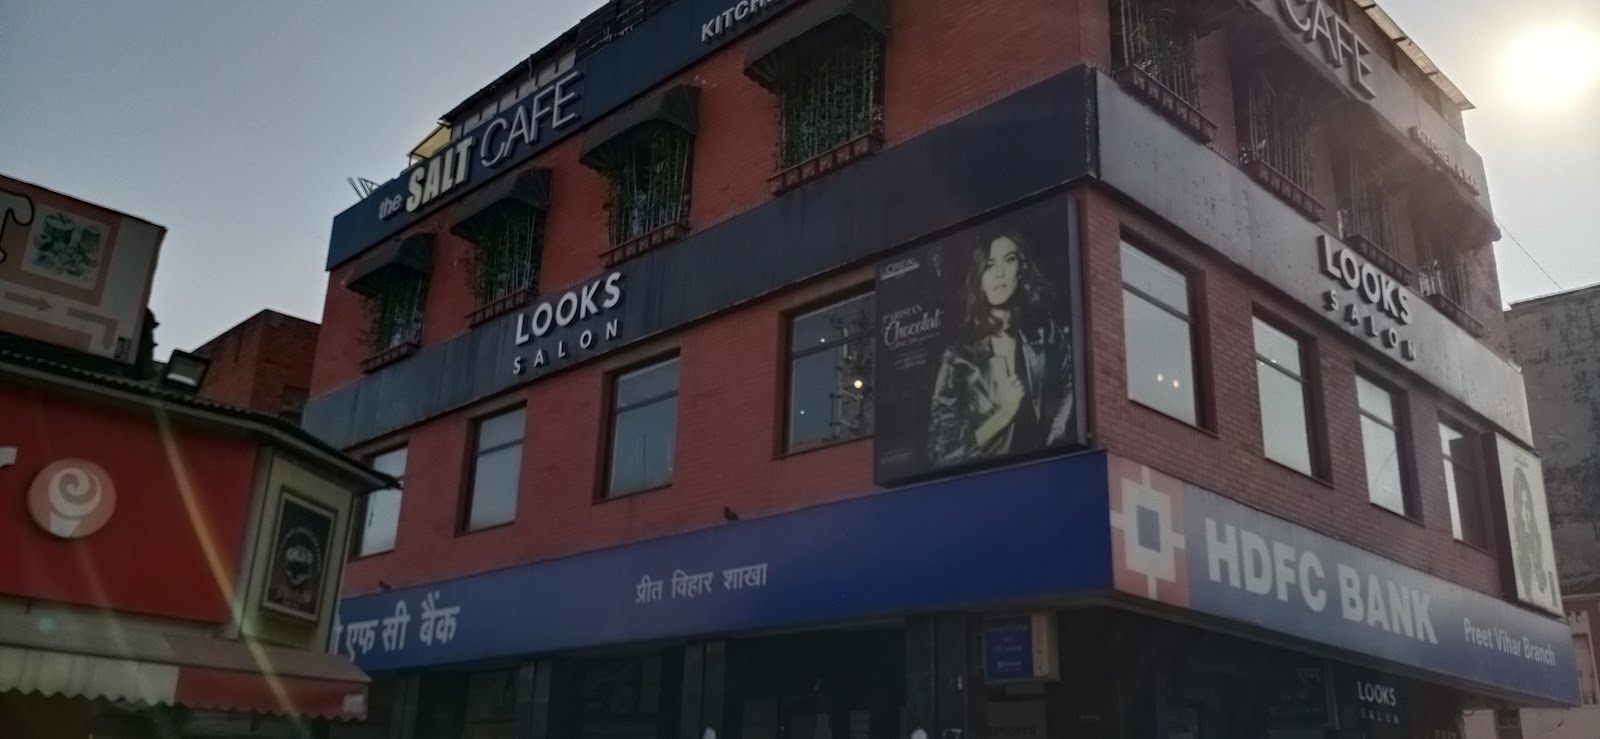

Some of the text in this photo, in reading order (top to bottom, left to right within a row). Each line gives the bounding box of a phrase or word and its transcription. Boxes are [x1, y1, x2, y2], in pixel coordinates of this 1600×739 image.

[378, 71, 583, 221] the SALT CAFE
[515, 271, 623, 346] LOOKS
[1319, 235, 1412, 325] LOOKS
[513, 318, 618, 375] SALON
[1325, 288, 1416, 361] SALON
[635, 563, 768, 605] प्रीत विहार शाखा
[1205, 517, 1438, 645] HDFC BANK
[420, 590, 461, 647] बैंक
[1463, 617, 1556, 667] Preet Vihar Branch
[1356, 680, 1397, 707] LOOKS
